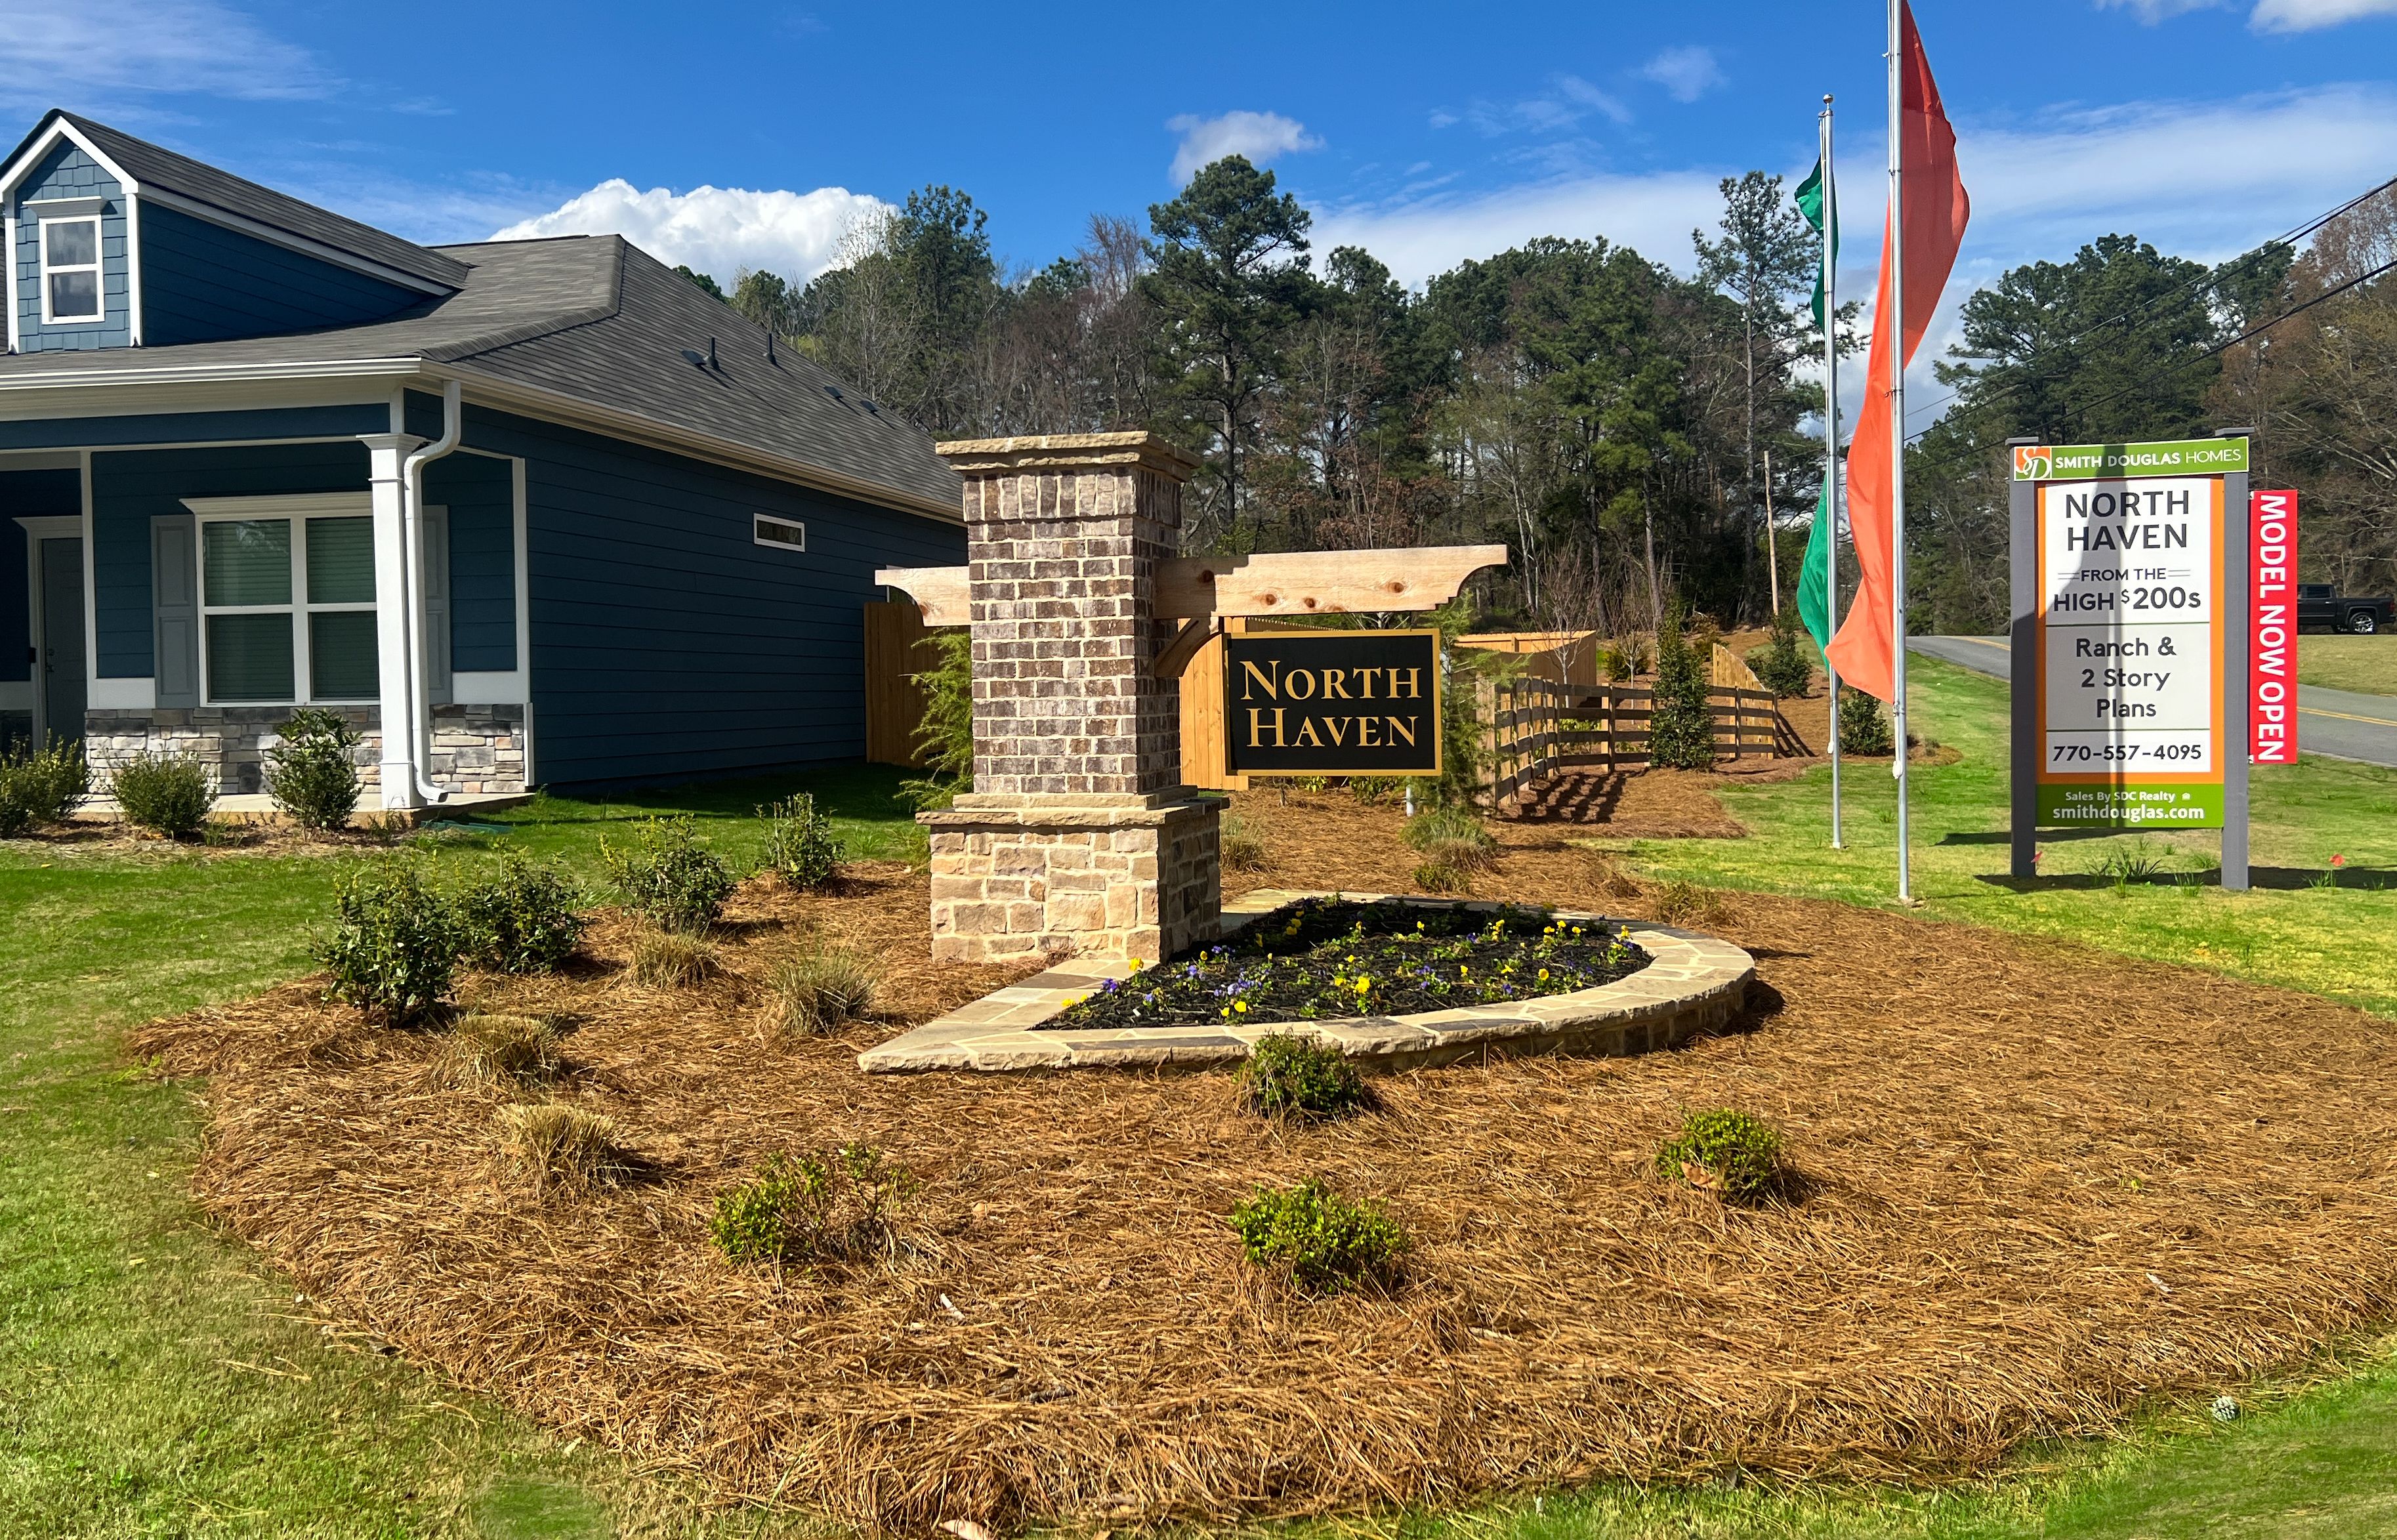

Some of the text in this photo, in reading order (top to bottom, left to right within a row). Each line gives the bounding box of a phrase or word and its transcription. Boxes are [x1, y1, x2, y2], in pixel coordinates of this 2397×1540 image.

[2055, 449, 2241, 470] SMITH DOUGLAS HOMES
[2066, 489, 2189, 518] NORTH
[2068, 523, 2187, 551] HAVEN
[2081, 568, 2167, 582] FROM THE
[2054, 586, 2201, 612] HIGH $200s
[2258, 494, 2287, 760] MODEL NOW OPEN
[2076, 636, 2177, 657] Ranch &
[1239, 660, 1423, 701] NORTH
[2081, 668, 2171, 692] 2 Story
[2096, 698, 2157, 718] Plans
[1245, 707, 1419, 747] HAVEN
[2053, 744, 2202, 762] 770-557-4095
[2065, 791, 2176, 804] Sales By SDC Realty
[2053, 804, 2205, 822] smithdouglas.com
